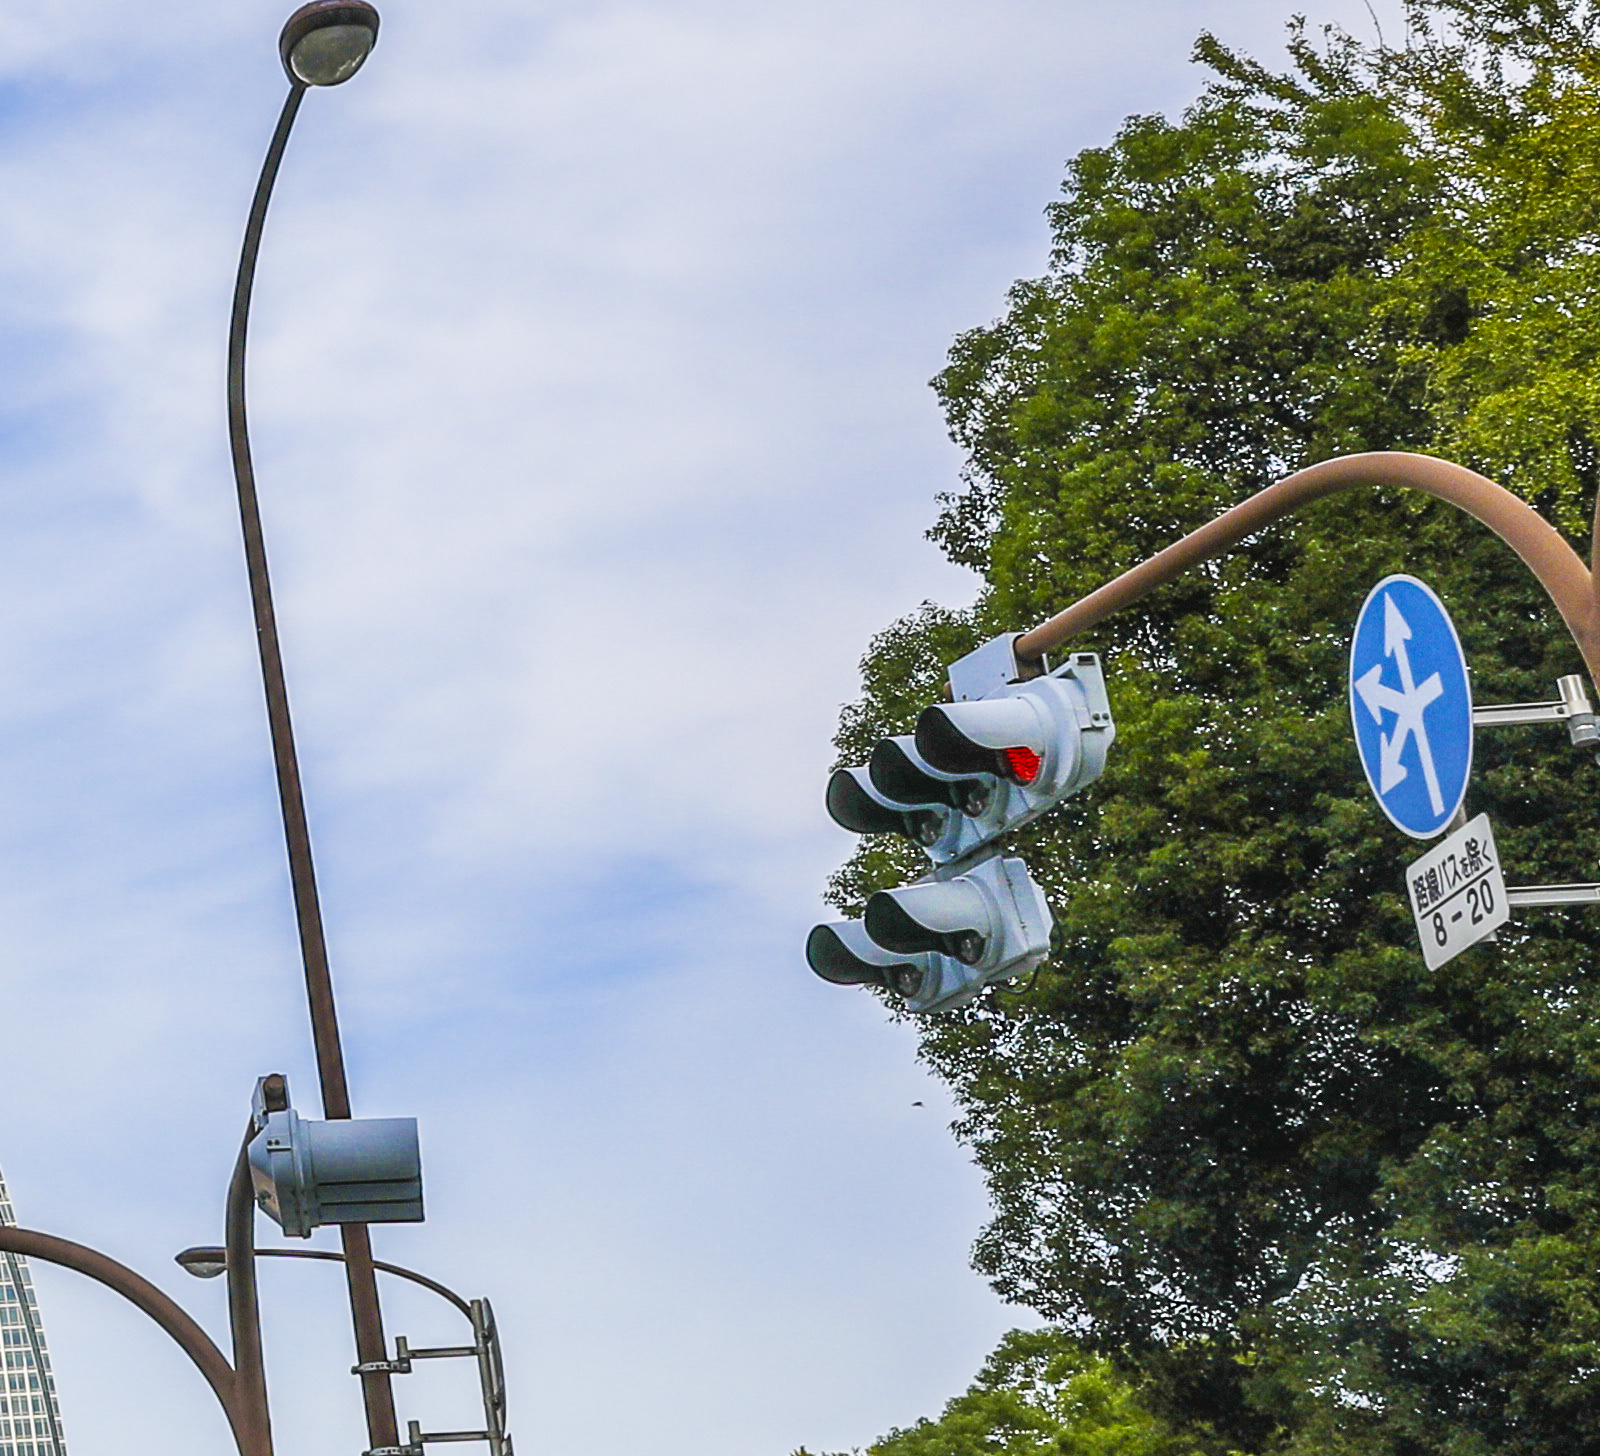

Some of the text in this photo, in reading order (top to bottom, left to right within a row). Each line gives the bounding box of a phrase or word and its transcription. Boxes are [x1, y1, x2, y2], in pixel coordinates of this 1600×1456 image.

[1413, 837, 1492, 913] 路線バスを除く
[1433, 879, 1494, 946] 8-20
